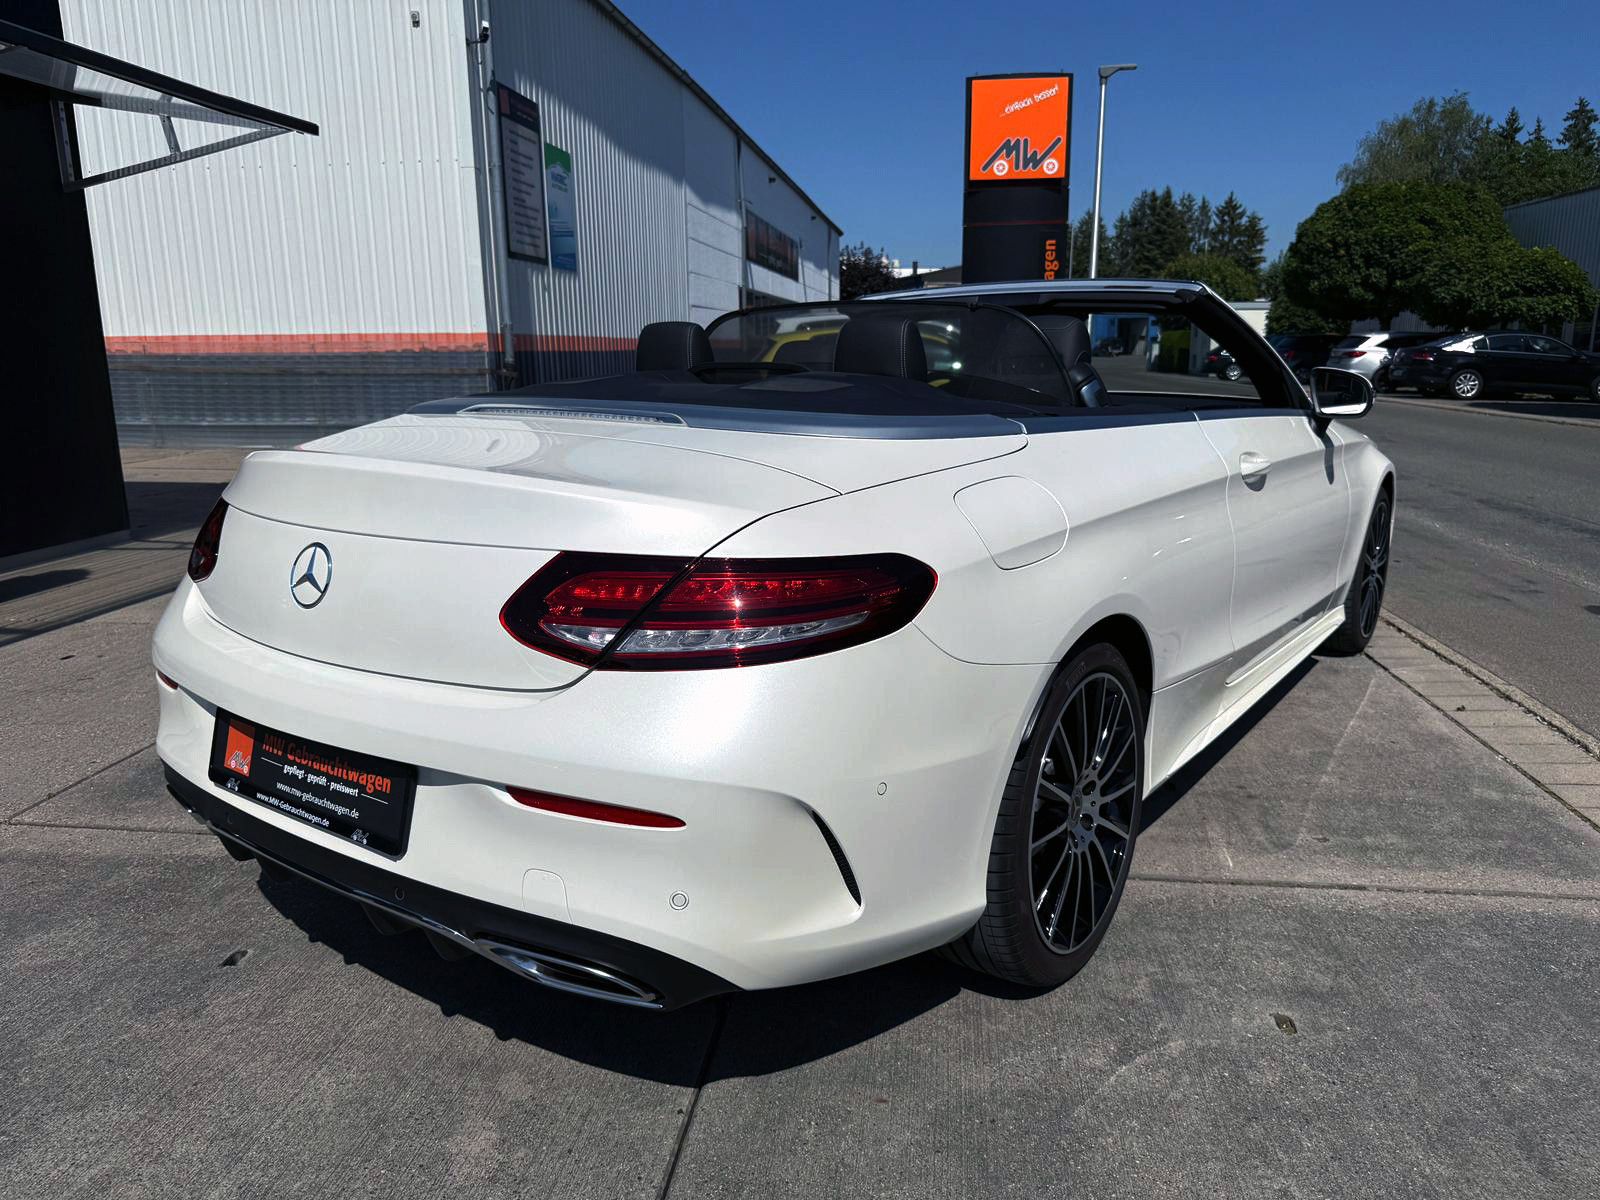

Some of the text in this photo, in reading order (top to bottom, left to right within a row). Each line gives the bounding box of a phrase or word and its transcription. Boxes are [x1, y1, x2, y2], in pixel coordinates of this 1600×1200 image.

[981, 136, 1062, 174] MW
[1044, 239, 1060, 280] agen
[262, 733, 392, 794] MW Gebrauchtwagen
[283, 764, 360, 797] gepflegt geprüft preiswert
[256, 792, 330, 828] www.MW-Gebrauchtwagen.de
[276, 781, 360, 819] www.mw-gebrauchtwagen.de
